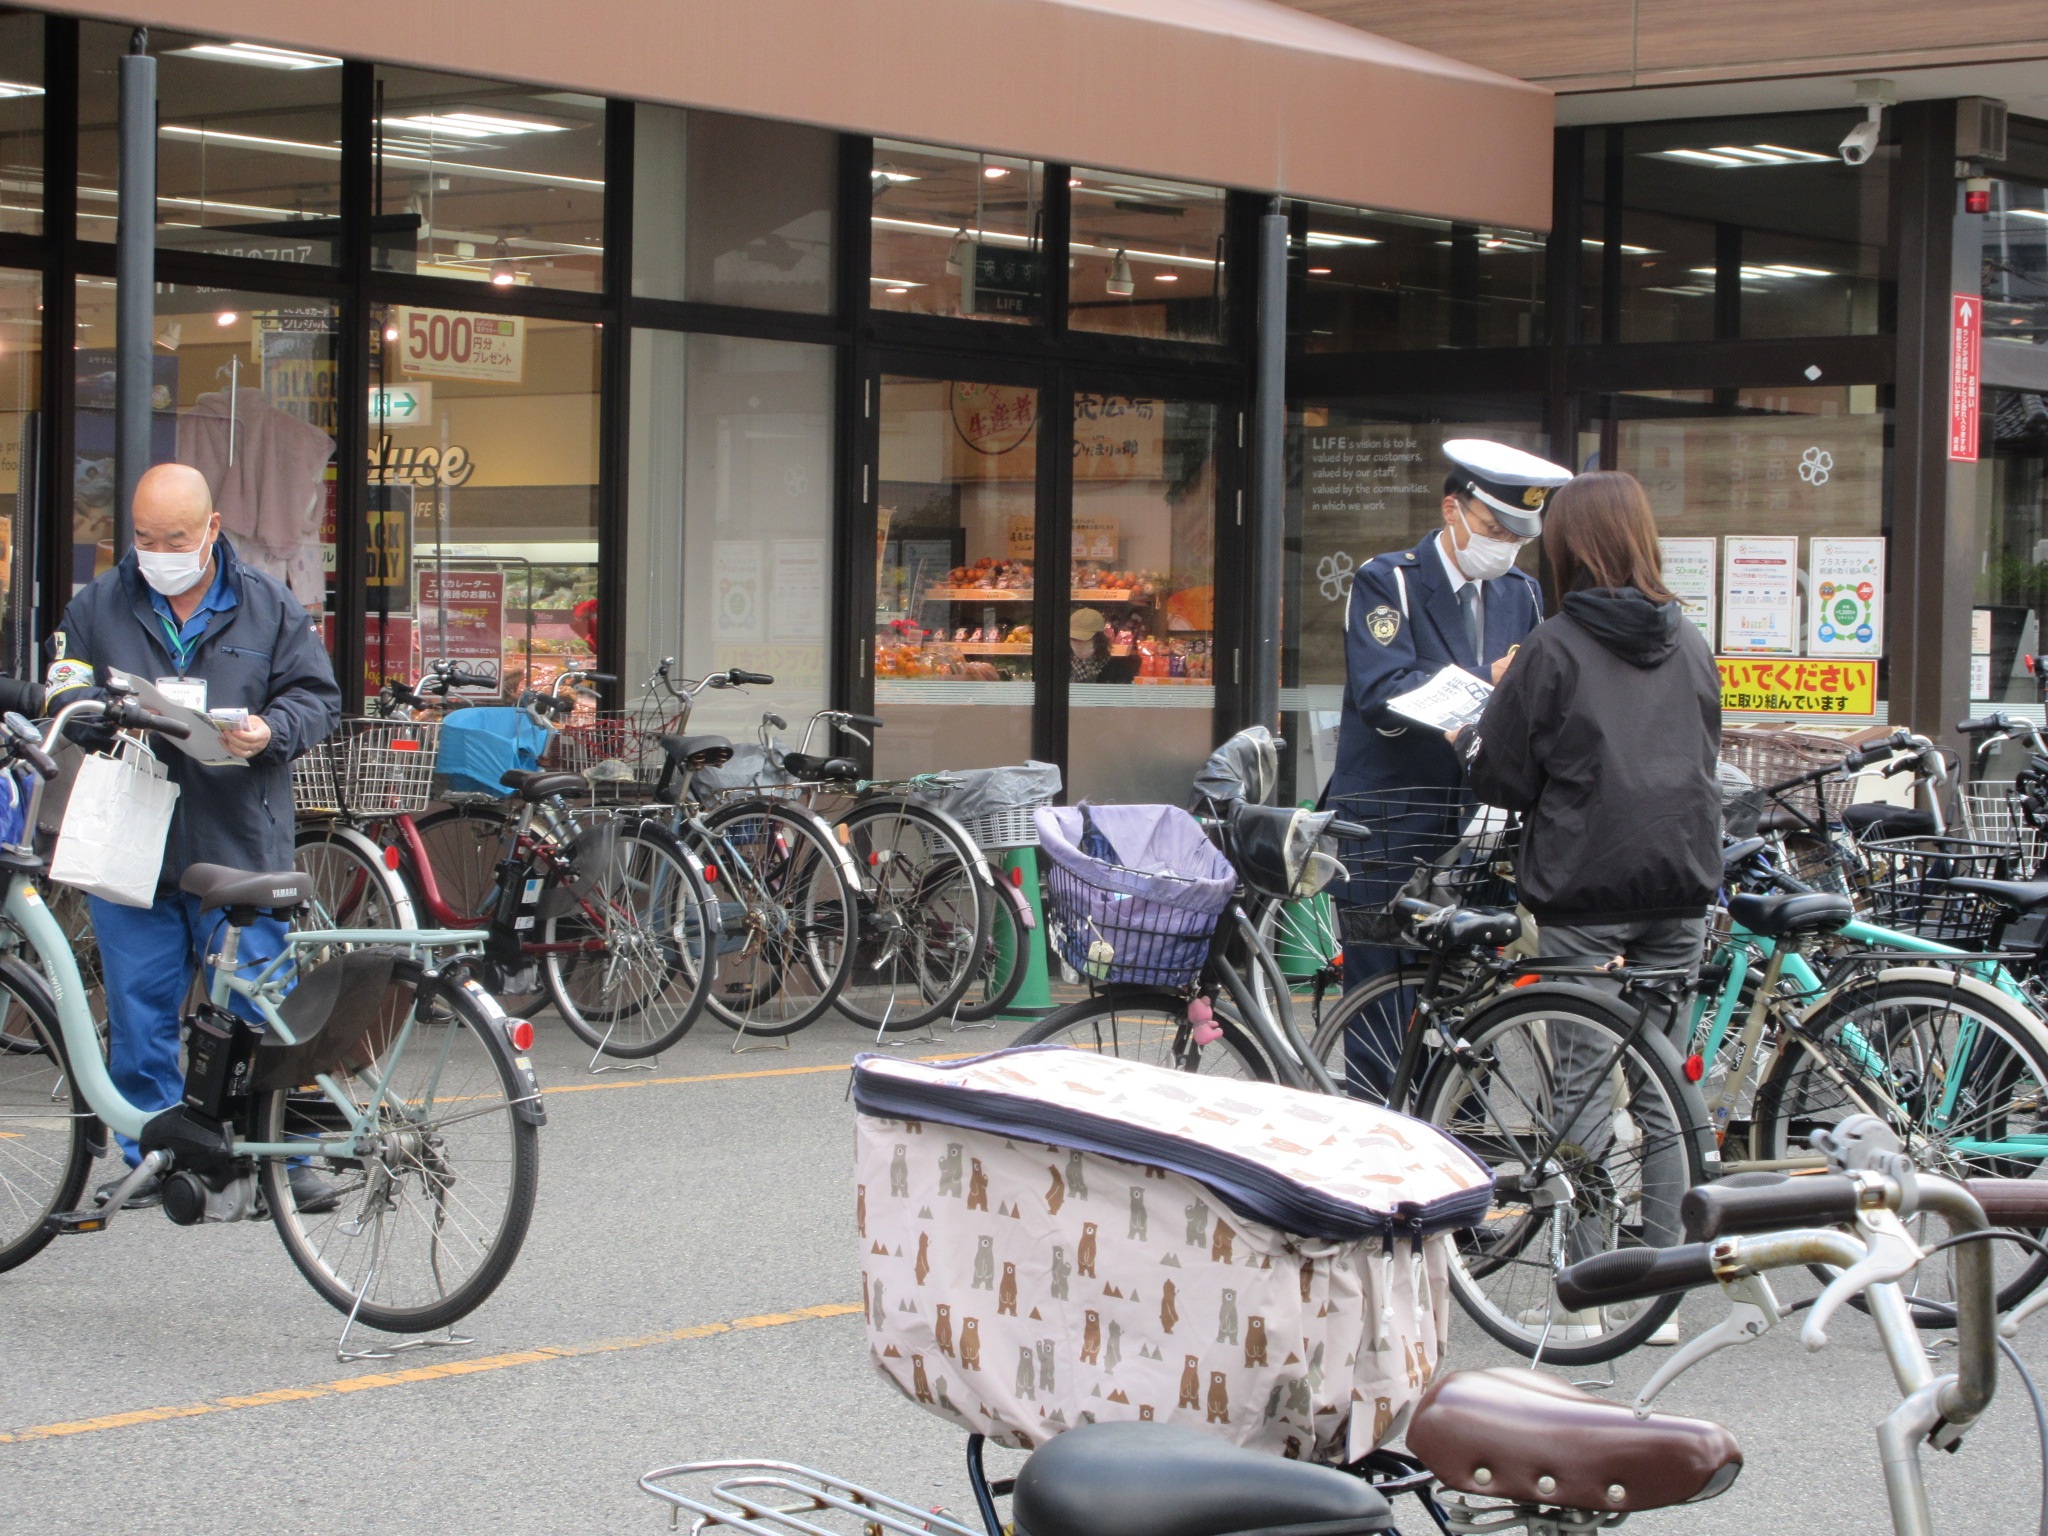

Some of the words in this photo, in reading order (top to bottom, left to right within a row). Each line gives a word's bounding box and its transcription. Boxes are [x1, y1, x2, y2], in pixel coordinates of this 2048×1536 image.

[409, 312, 472, 363] 500
[473, 337, 493, 351] 円分
[473, 351, 512, 366] プレゼント
[1356, 439, 1382, 449] vision
[1383, 438, 1391, 449] is
[1393, 439, 1404, 448] to
[1405, 438, 1418, 448] be
[1312, 452, 1341, 463] valued
[1343, 452, 1354, 465] by
[1356, 454, 1371, 463] our
[1373, 452, 1423, 463] customers,
[1312, 467, 1341, 478] valued
[1342, 467, 1354, 480] by
[1355, 469, 1371, 478] our
[1312, 483, 1341, 494] valued
[1342, 483, 1354, 496] by
[1355, 482, 1371, 494] the
[1373, 483, 1431, 494] communities,
[1312, 501, 1320, 511] in
[1322, 500, 1346, 511] which
[1348, 502, 1361, 511] we
[1820, 558, 1862, 567] プラスチック
[272, 887, 298, 899] YAMAHA
